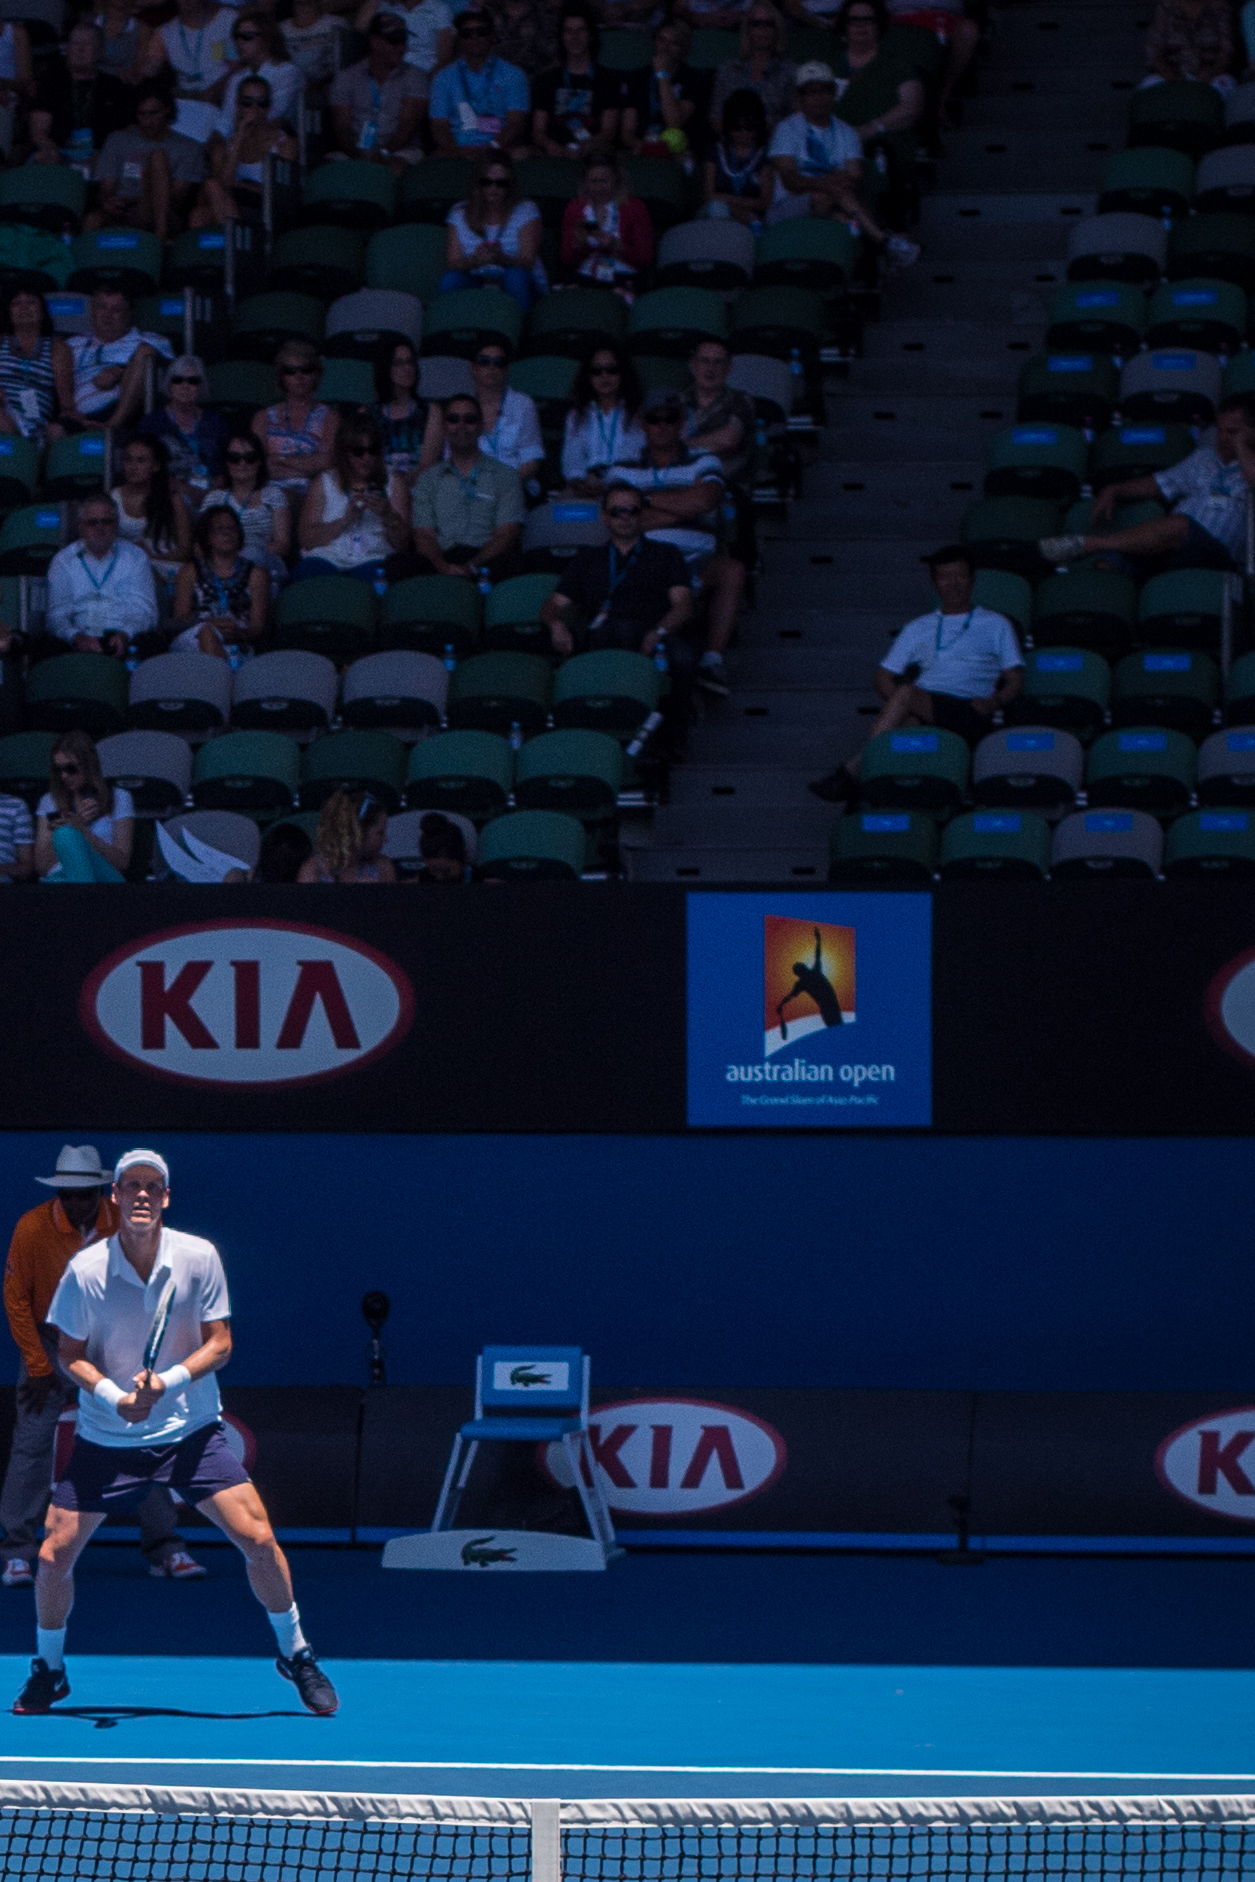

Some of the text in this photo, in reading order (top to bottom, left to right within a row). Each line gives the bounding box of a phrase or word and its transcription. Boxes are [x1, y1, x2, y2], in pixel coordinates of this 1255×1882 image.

[136, 961, 362, 1050] KIA
[726, 1058, 895, 1087] australian open
[580, 1425, 744, 1488] KIA
